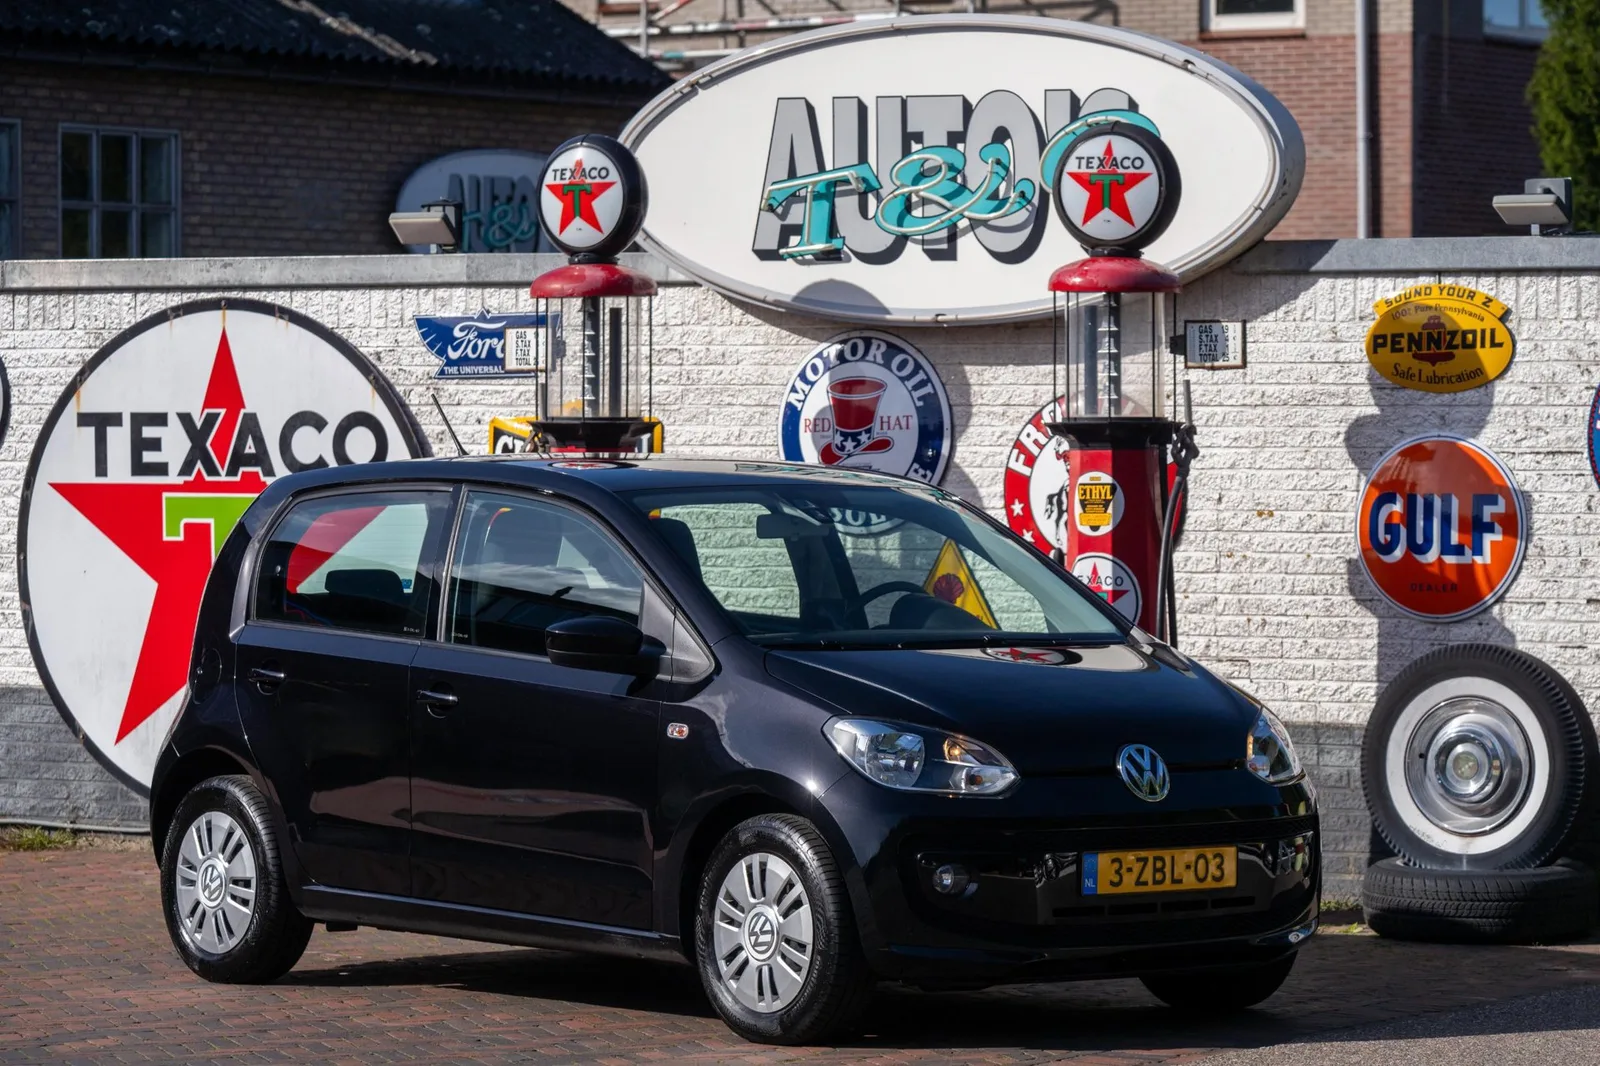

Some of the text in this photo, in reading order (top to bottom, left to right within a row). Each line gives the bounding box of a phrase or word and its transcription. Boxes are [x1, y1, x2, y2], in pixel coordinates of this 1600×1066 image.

[1075, 156, 1145, 170] TEXACO
[552, 167, 610, 181] TEXACO
[1384, 285, 1494, 309] SOUND YOUR Z
[1433, 303, 1486, 323] Pennsylvania
[515, 331, 527, 340] GAS
[1199, 325, 1213, 334] GAS
[515, 340, 532, 348] S.TAX
[1199, 334, 1219, 343] S.TAX
[1372, 328, 1505, 355] PENNZOIL
[515, 349, 531, 357] F.TAX
[1199, 344, 1218, 353] F.TAX
[515, 358, 532, 366] TOTAL
[1199, 354, 1219, 362] TOTAL
[443, 365, 505, 375] THE UNIVERSAL
[787, 338, 935, 412] MOTOR OIL
[1391, 362, 1485, 386] Safe Lubrication
[804, 414, 914, 434] RED HAT
[76, 410, 389, 478] TEXACO
[1079, 484, 1113, 500] ETHYL
[1369, 491, 1506, 564] GULF
[1410, 582, 1459, 593] DEALER
[1109, 853, 1225, 888] 3-ZBL-03
[1084, 878, 1096, 888] NL
